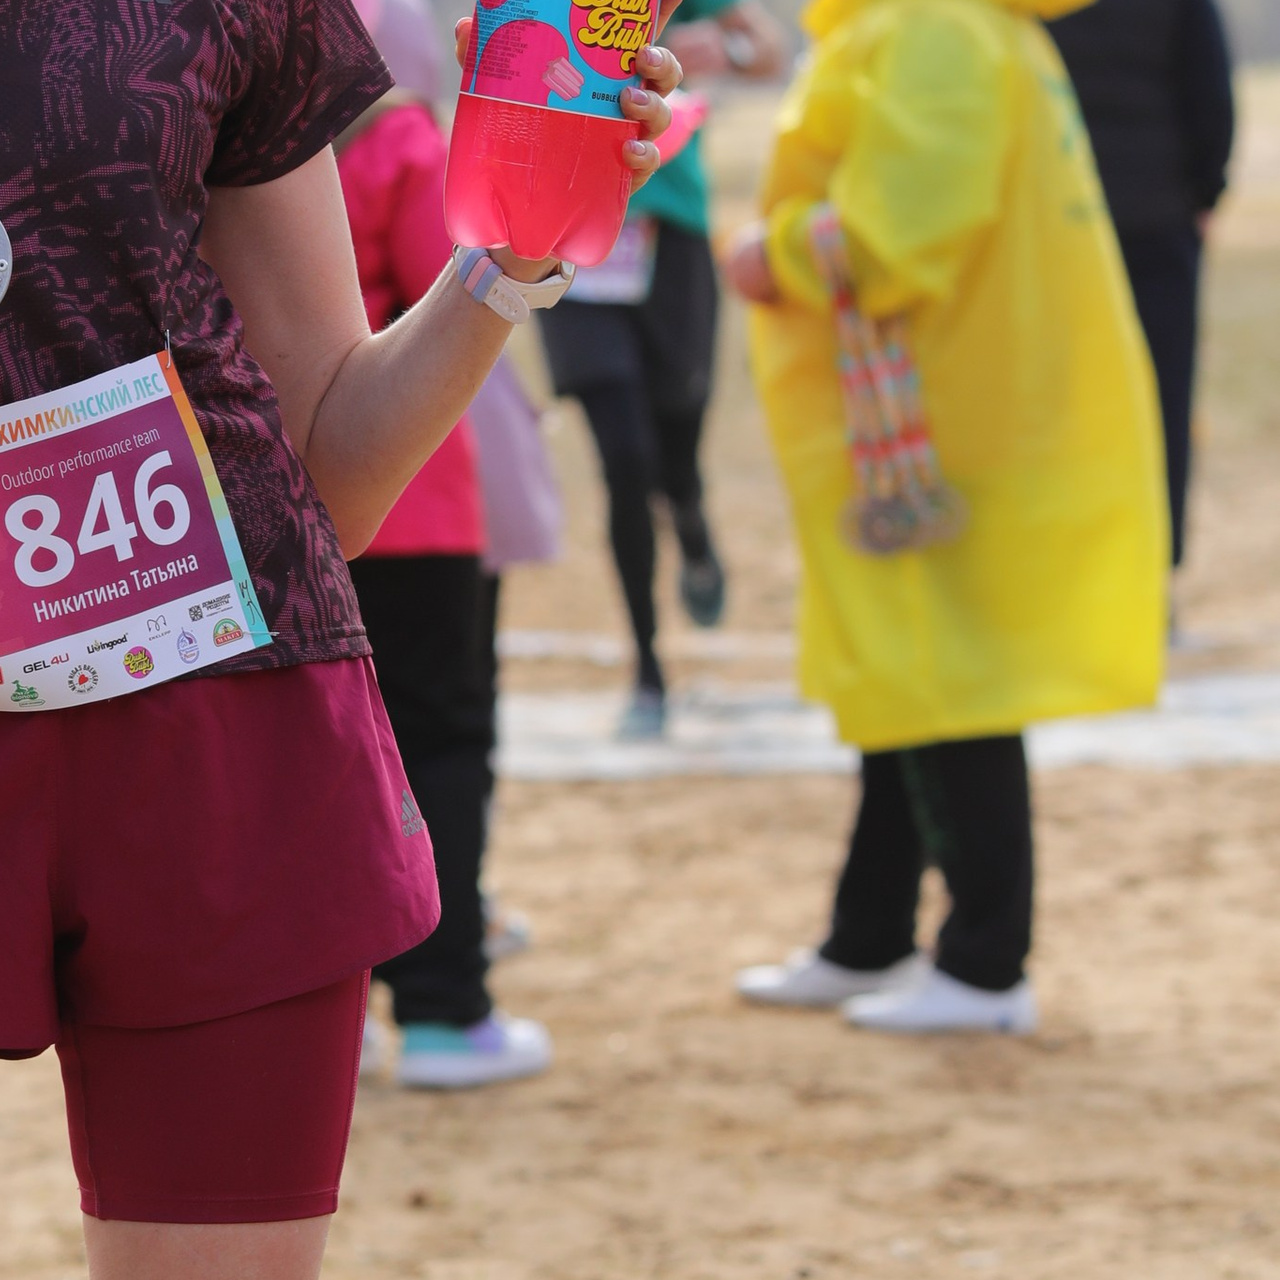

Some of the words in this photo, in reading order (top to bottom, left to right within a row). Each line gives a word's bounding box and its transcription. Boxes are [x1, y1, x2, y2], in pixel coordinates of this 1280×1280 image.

[578, 6, 653, 60] Bubl
[591, 91, 616, 103] BUBBLE
[131, 372, 164, 402] ЛЕС
[1, 463, 55, 491] Outdoor
[58, 437, 132, 478] performance
[133, 427, 161, 449] team
[4, 450, 191, 588] 846
[33, 577, 130, 623] Никитина
[130, 554, 199, 591] Татьяна
[23, 653, 70, 674] GEL4U
[87, 634, 128, 654] Livingood
